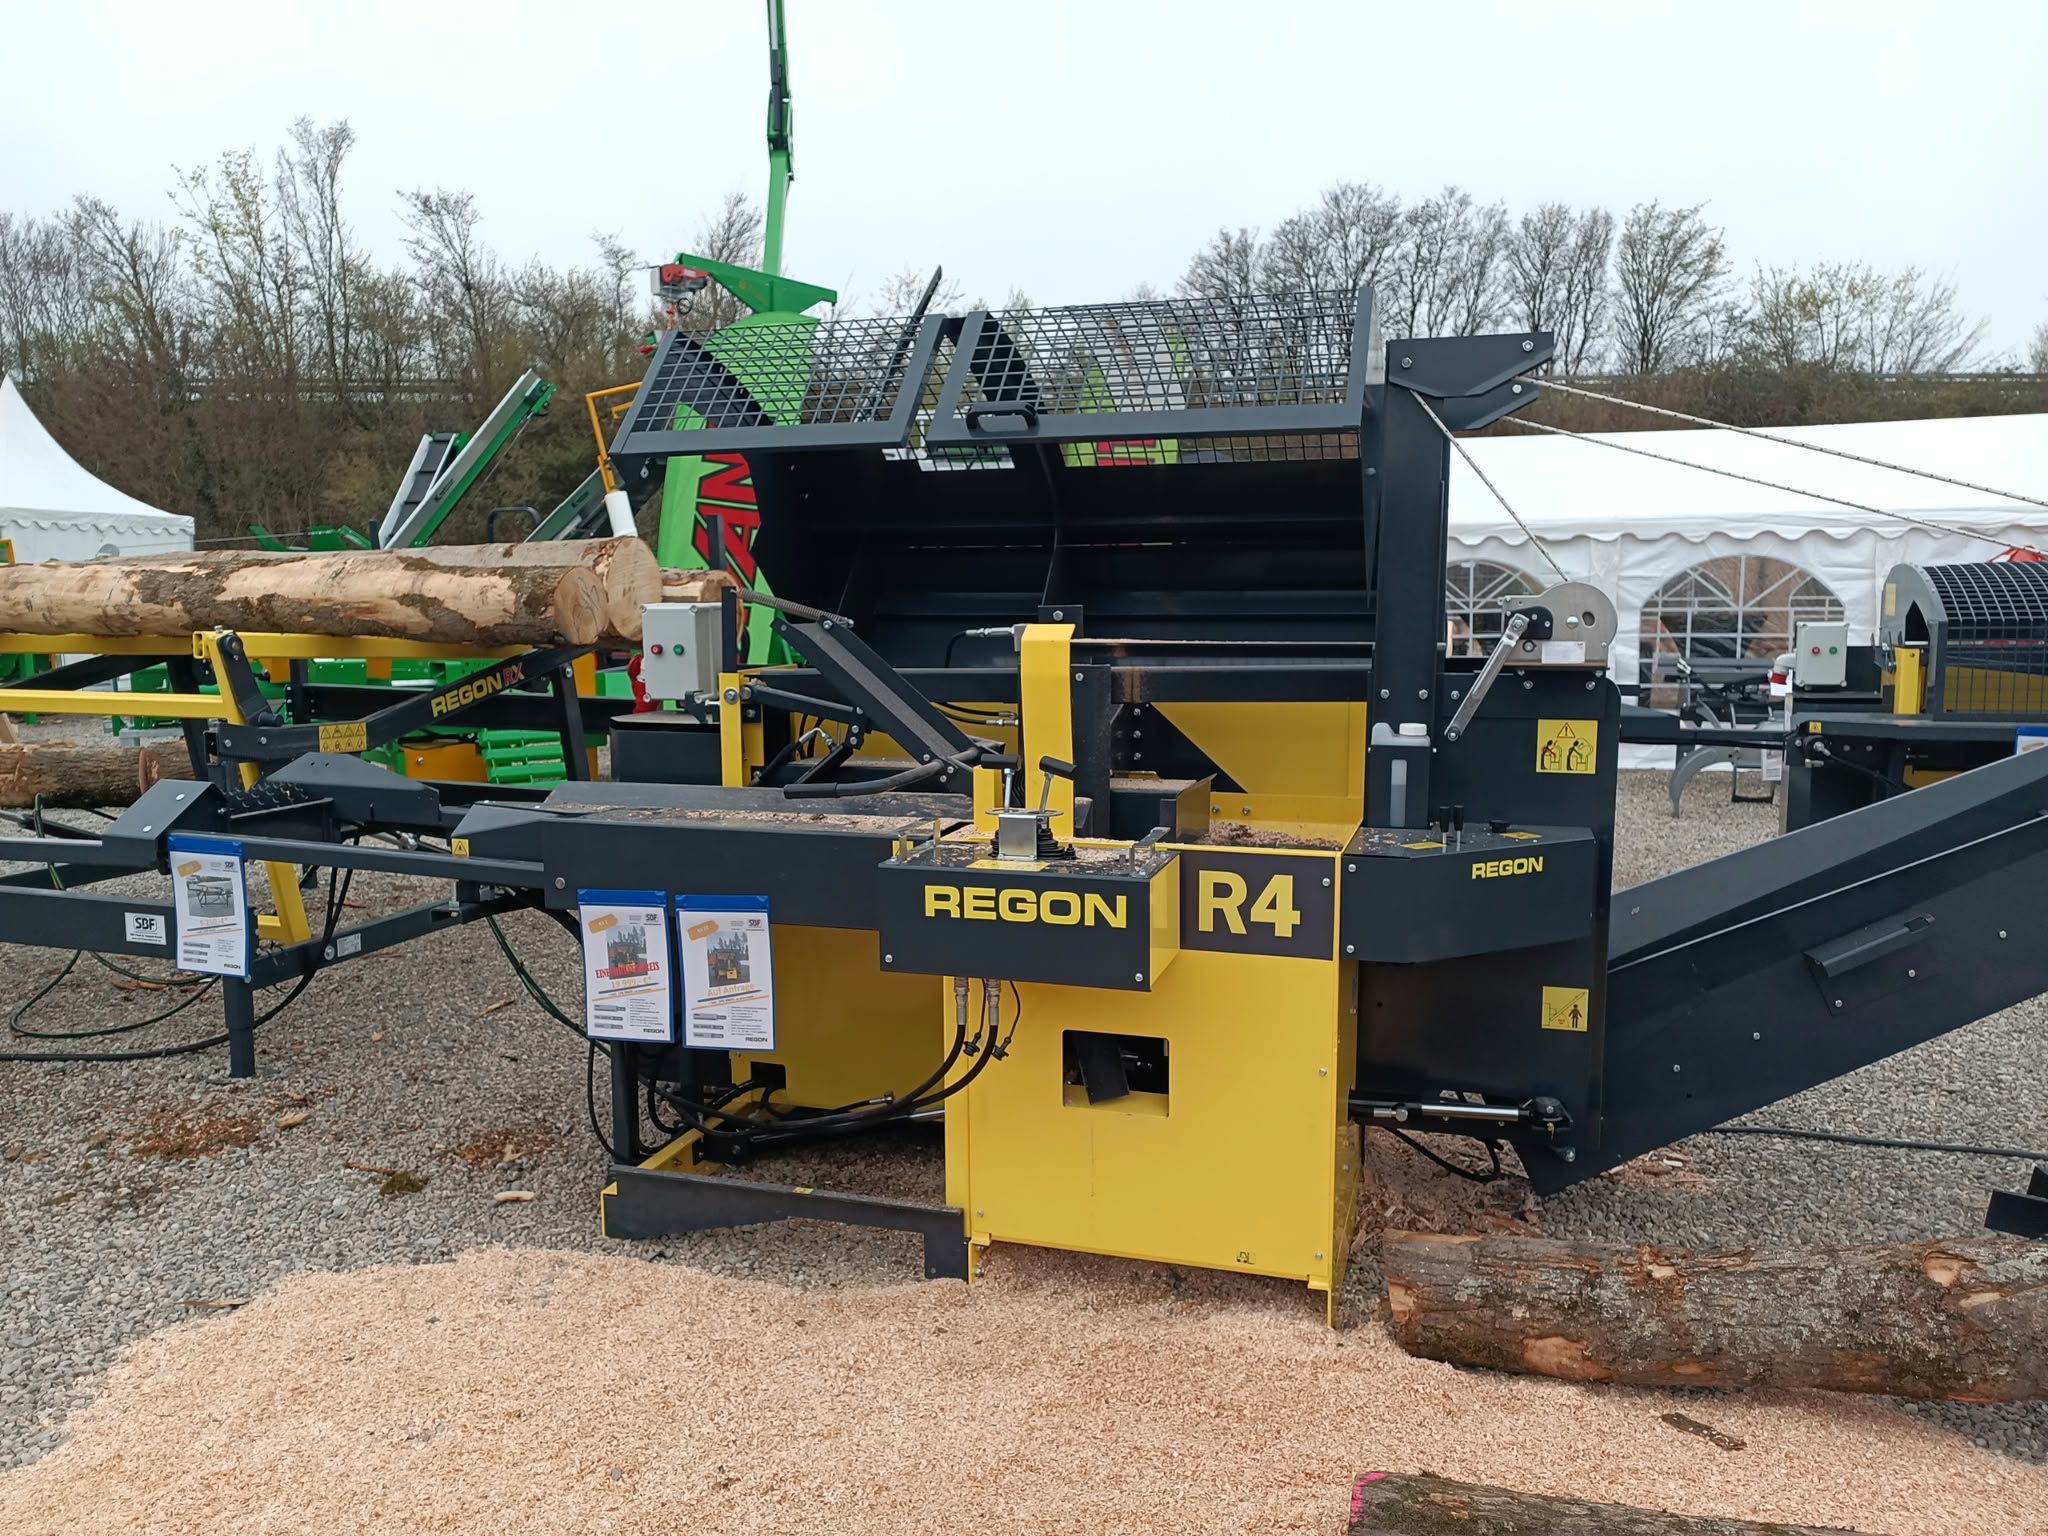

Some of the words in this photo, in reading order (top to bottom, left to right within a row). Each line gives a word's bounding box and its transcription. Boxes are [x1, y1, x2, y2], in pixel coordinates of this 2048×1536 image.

[431, 672, 502, 718] REGON
[1471, 856, 1543, 879] REGON
[135, 917, 155, 930] SBF
[923, 885, 1127, 928] REGON
[1198, 869, 1301, 938] R4
